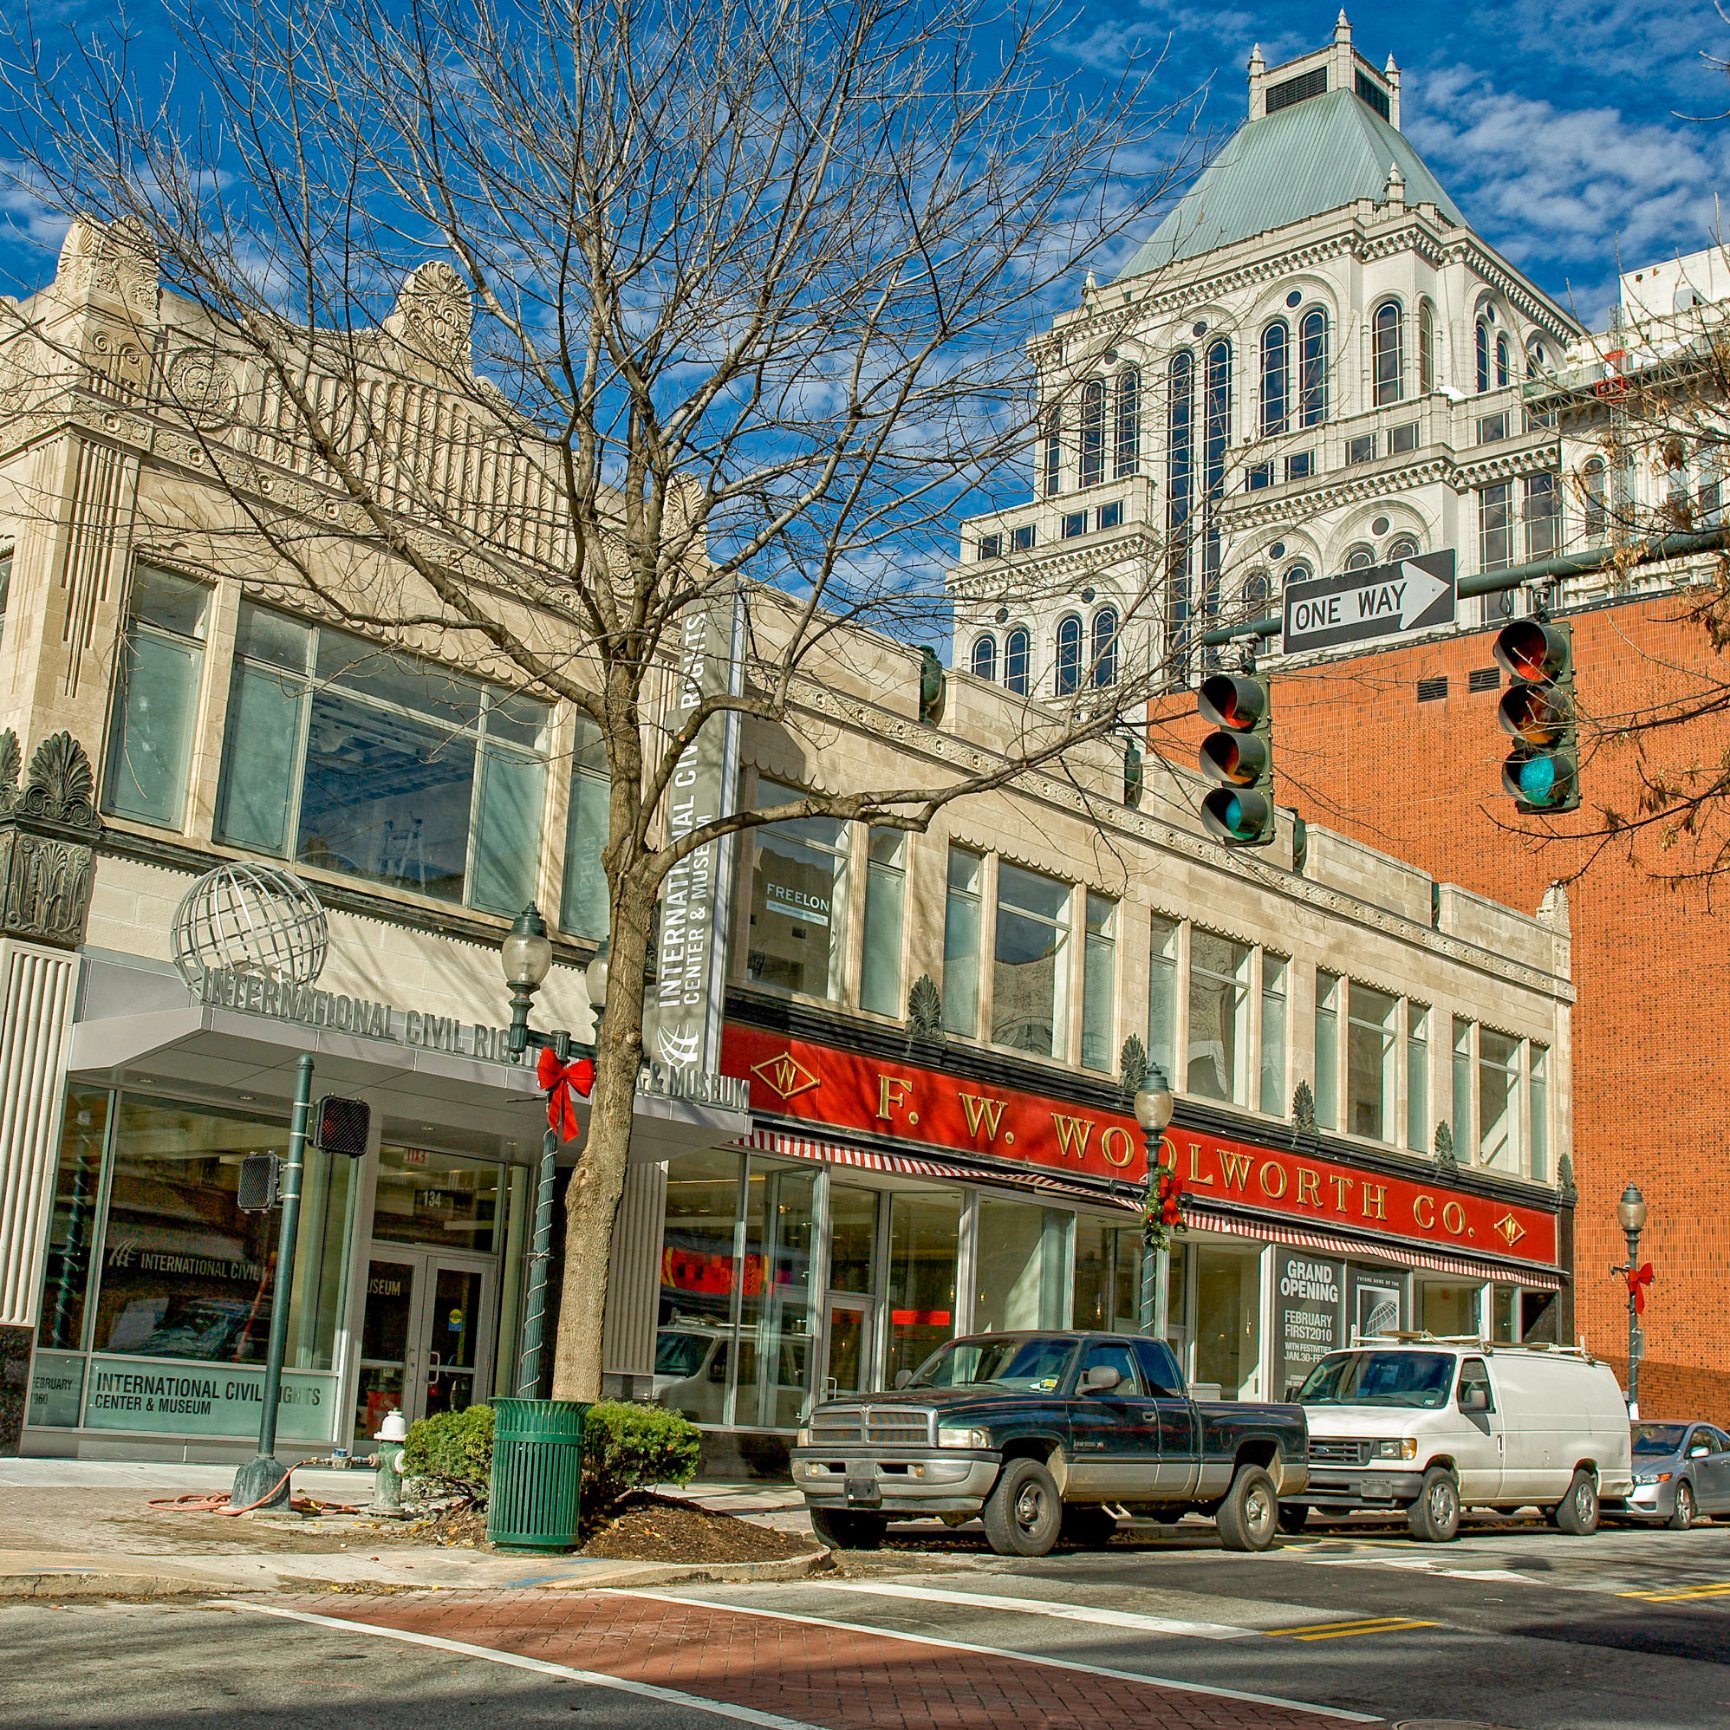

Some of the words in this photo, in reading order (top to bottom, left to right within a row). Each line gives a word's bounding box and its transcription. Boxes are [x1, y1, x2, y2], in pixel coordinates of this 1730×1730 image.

[1296, 597, 1341, 630] ONE
[1358, 582, 1407, 617] WAY
[680, 613, 707, 709] RIGHTS
[691, 814, 712, 900] MUSEM
[767, 883, 829, 912] FREELON
[690, 906, 706, 921] &
[684, 927, 704, 1005] CENTER
[201, 965, 397, 1041] INTERNATIONAL
[405, 1009, 465, 1054] CIVIL
[667, 1064, 750, 1112] MUSEUM
[876, 1074, 920, 1125] F.
[958, 1092, 1015, 1145] W.
[1413, 1195, 1475, 1238] CO.
[423, 1190, 441, 1207] 134
[141, 1252, 228, 1278] INTERNATIONAL
[1287, 1260, 1333, 1283] GRAND
[367, 1278, 401, 1296] USEUM
[1280, 1277, 1339, 1303] OPENING
[1284, 1310, 1333, 1328] FEBRUARY
[1284, 1341, 1300, 1351] WITH
[96, 1372, 220, 1399] INTERNATIONAL
[225, 1382, 263, 1402] CIVIL
[95, 1394, 143, 1409] CENTER
[145, 1398, 154, 1411] &
[158, 1398, 211, 1415] MUSEUM
